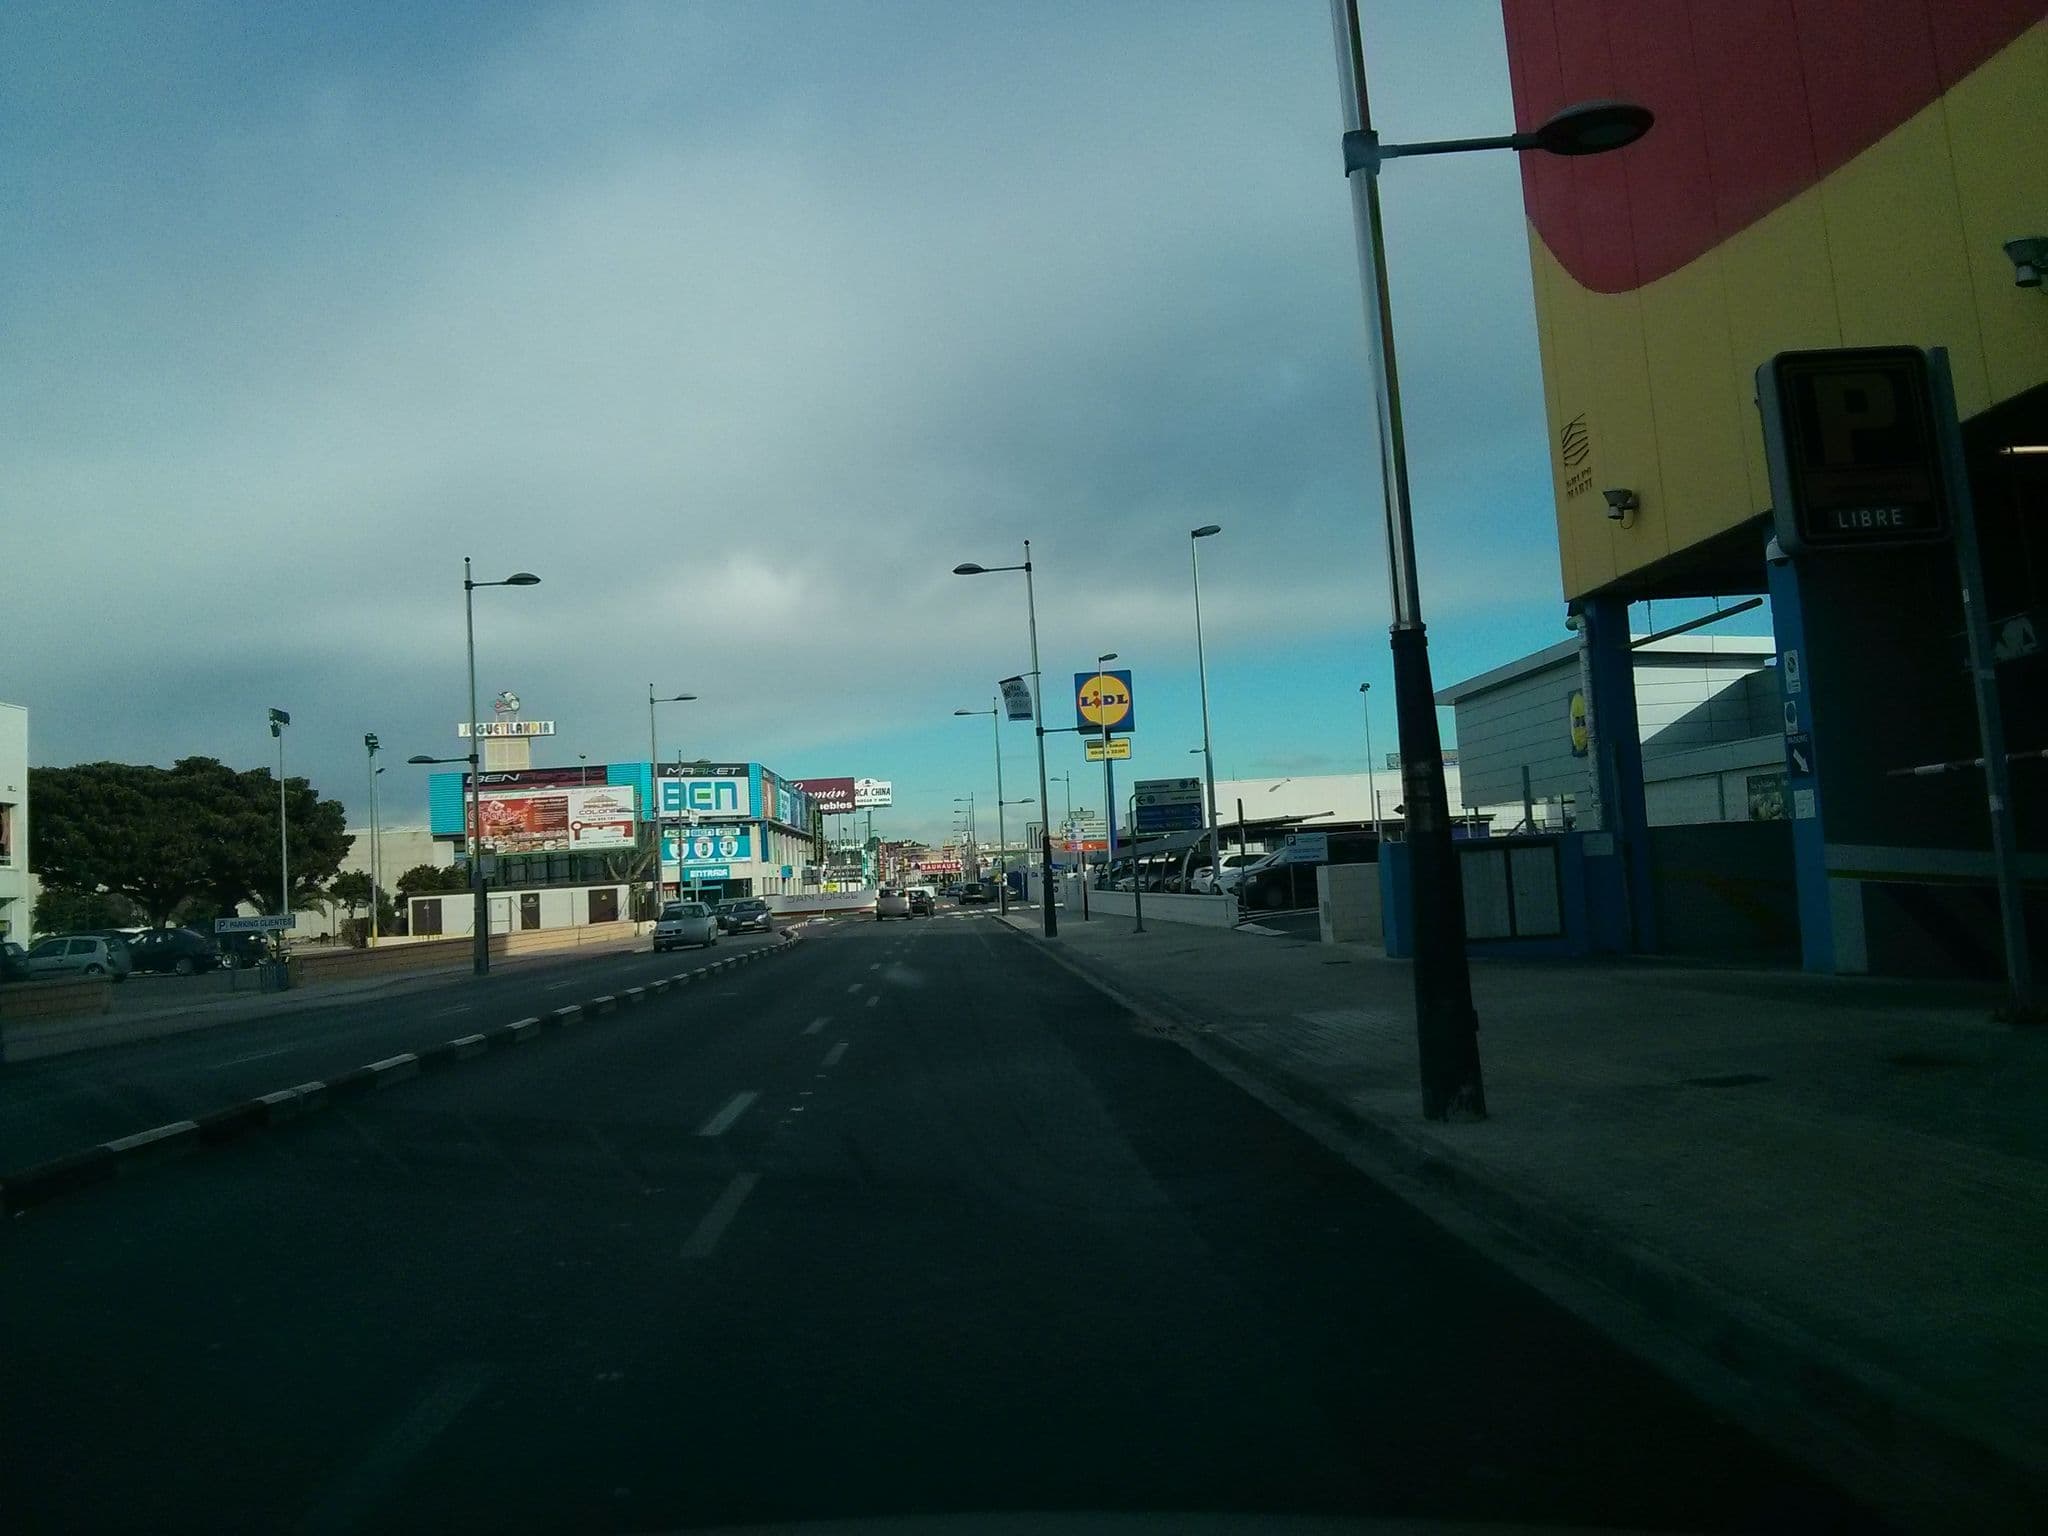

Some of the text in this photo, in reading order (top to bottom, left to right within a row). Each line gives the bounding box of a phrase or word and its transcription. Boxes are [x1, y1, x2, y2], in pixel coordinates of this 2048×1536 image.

[1838, 508, 1904, 528] LIBRE
[462, 722, 550, 736] JGUETILANDIA
[666, 767, 740, 775] MARKET
[663, 782, 738, 811] BEN
[871, 787, 891, 797] CHINA
[921, 863, 956, 871] BAUHAUS
[690, 868, 728, 878] ENTRADA
[787, 894, 815, 904] SAN
[229, 919, 259, 929] PARKING
[259, 917, 292, 928] CLIENTES
